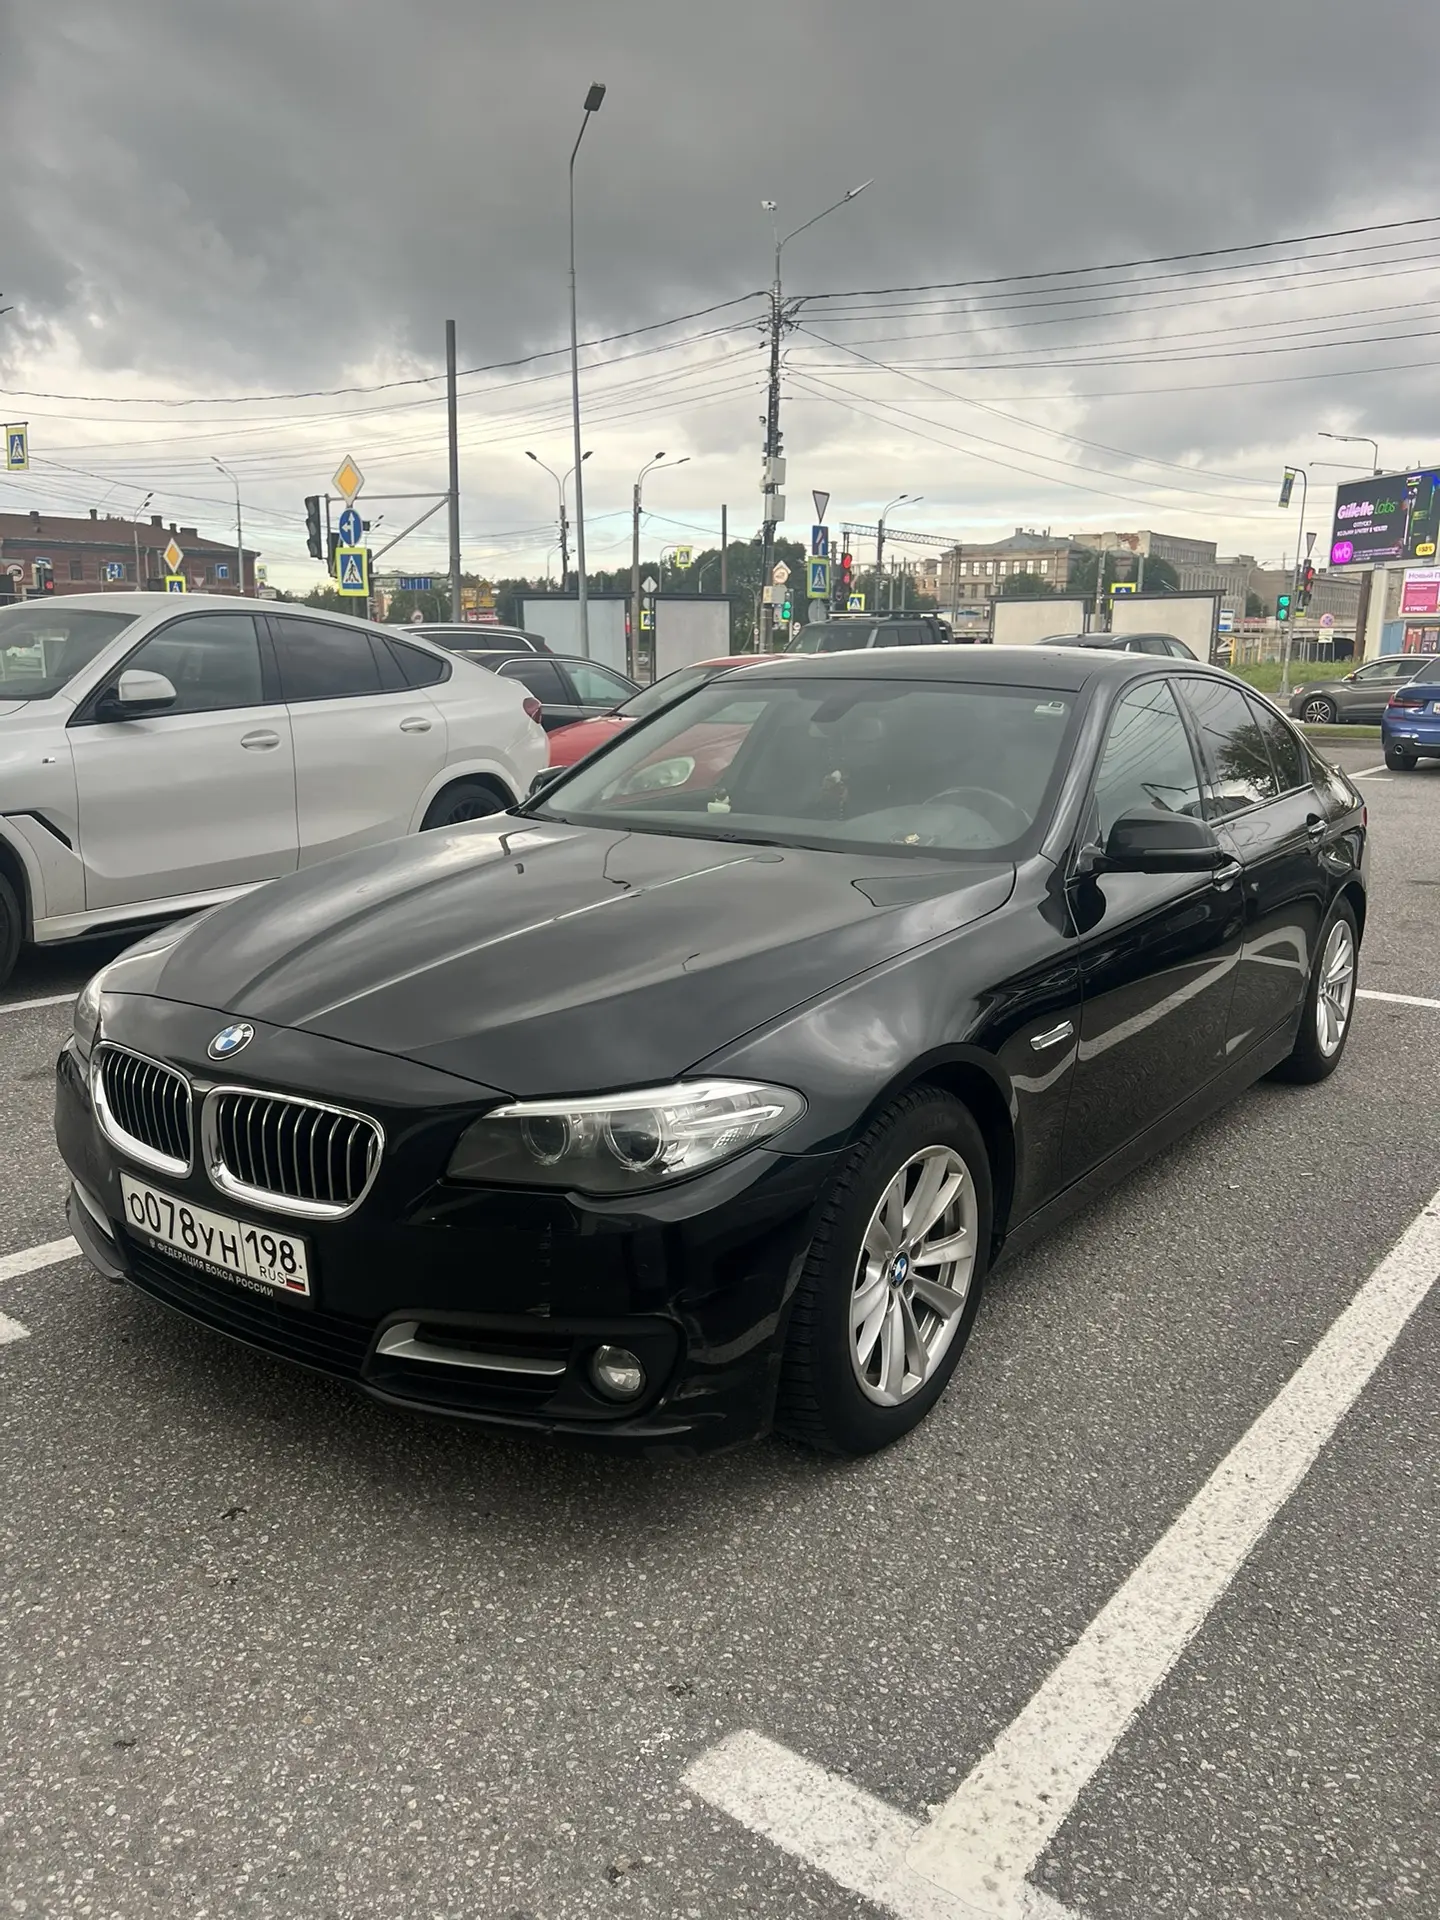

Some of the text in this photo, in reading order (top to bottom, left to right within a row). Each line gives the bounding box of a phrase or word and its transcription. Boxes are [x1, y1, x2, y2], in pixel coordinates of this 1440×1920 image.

[1337, 498, 1395, 519] Gillette Labs
[1335, 545, 1350, 560] wb
[1408, 572, 1433, 580] Новый
[245, 1230, 297, 1274] 198
[157, 1242, 274, 1297] ФЕДЕРАЦИЯ БОКСА РОССИИ
[260, 1265, 285, 1285] RUS
